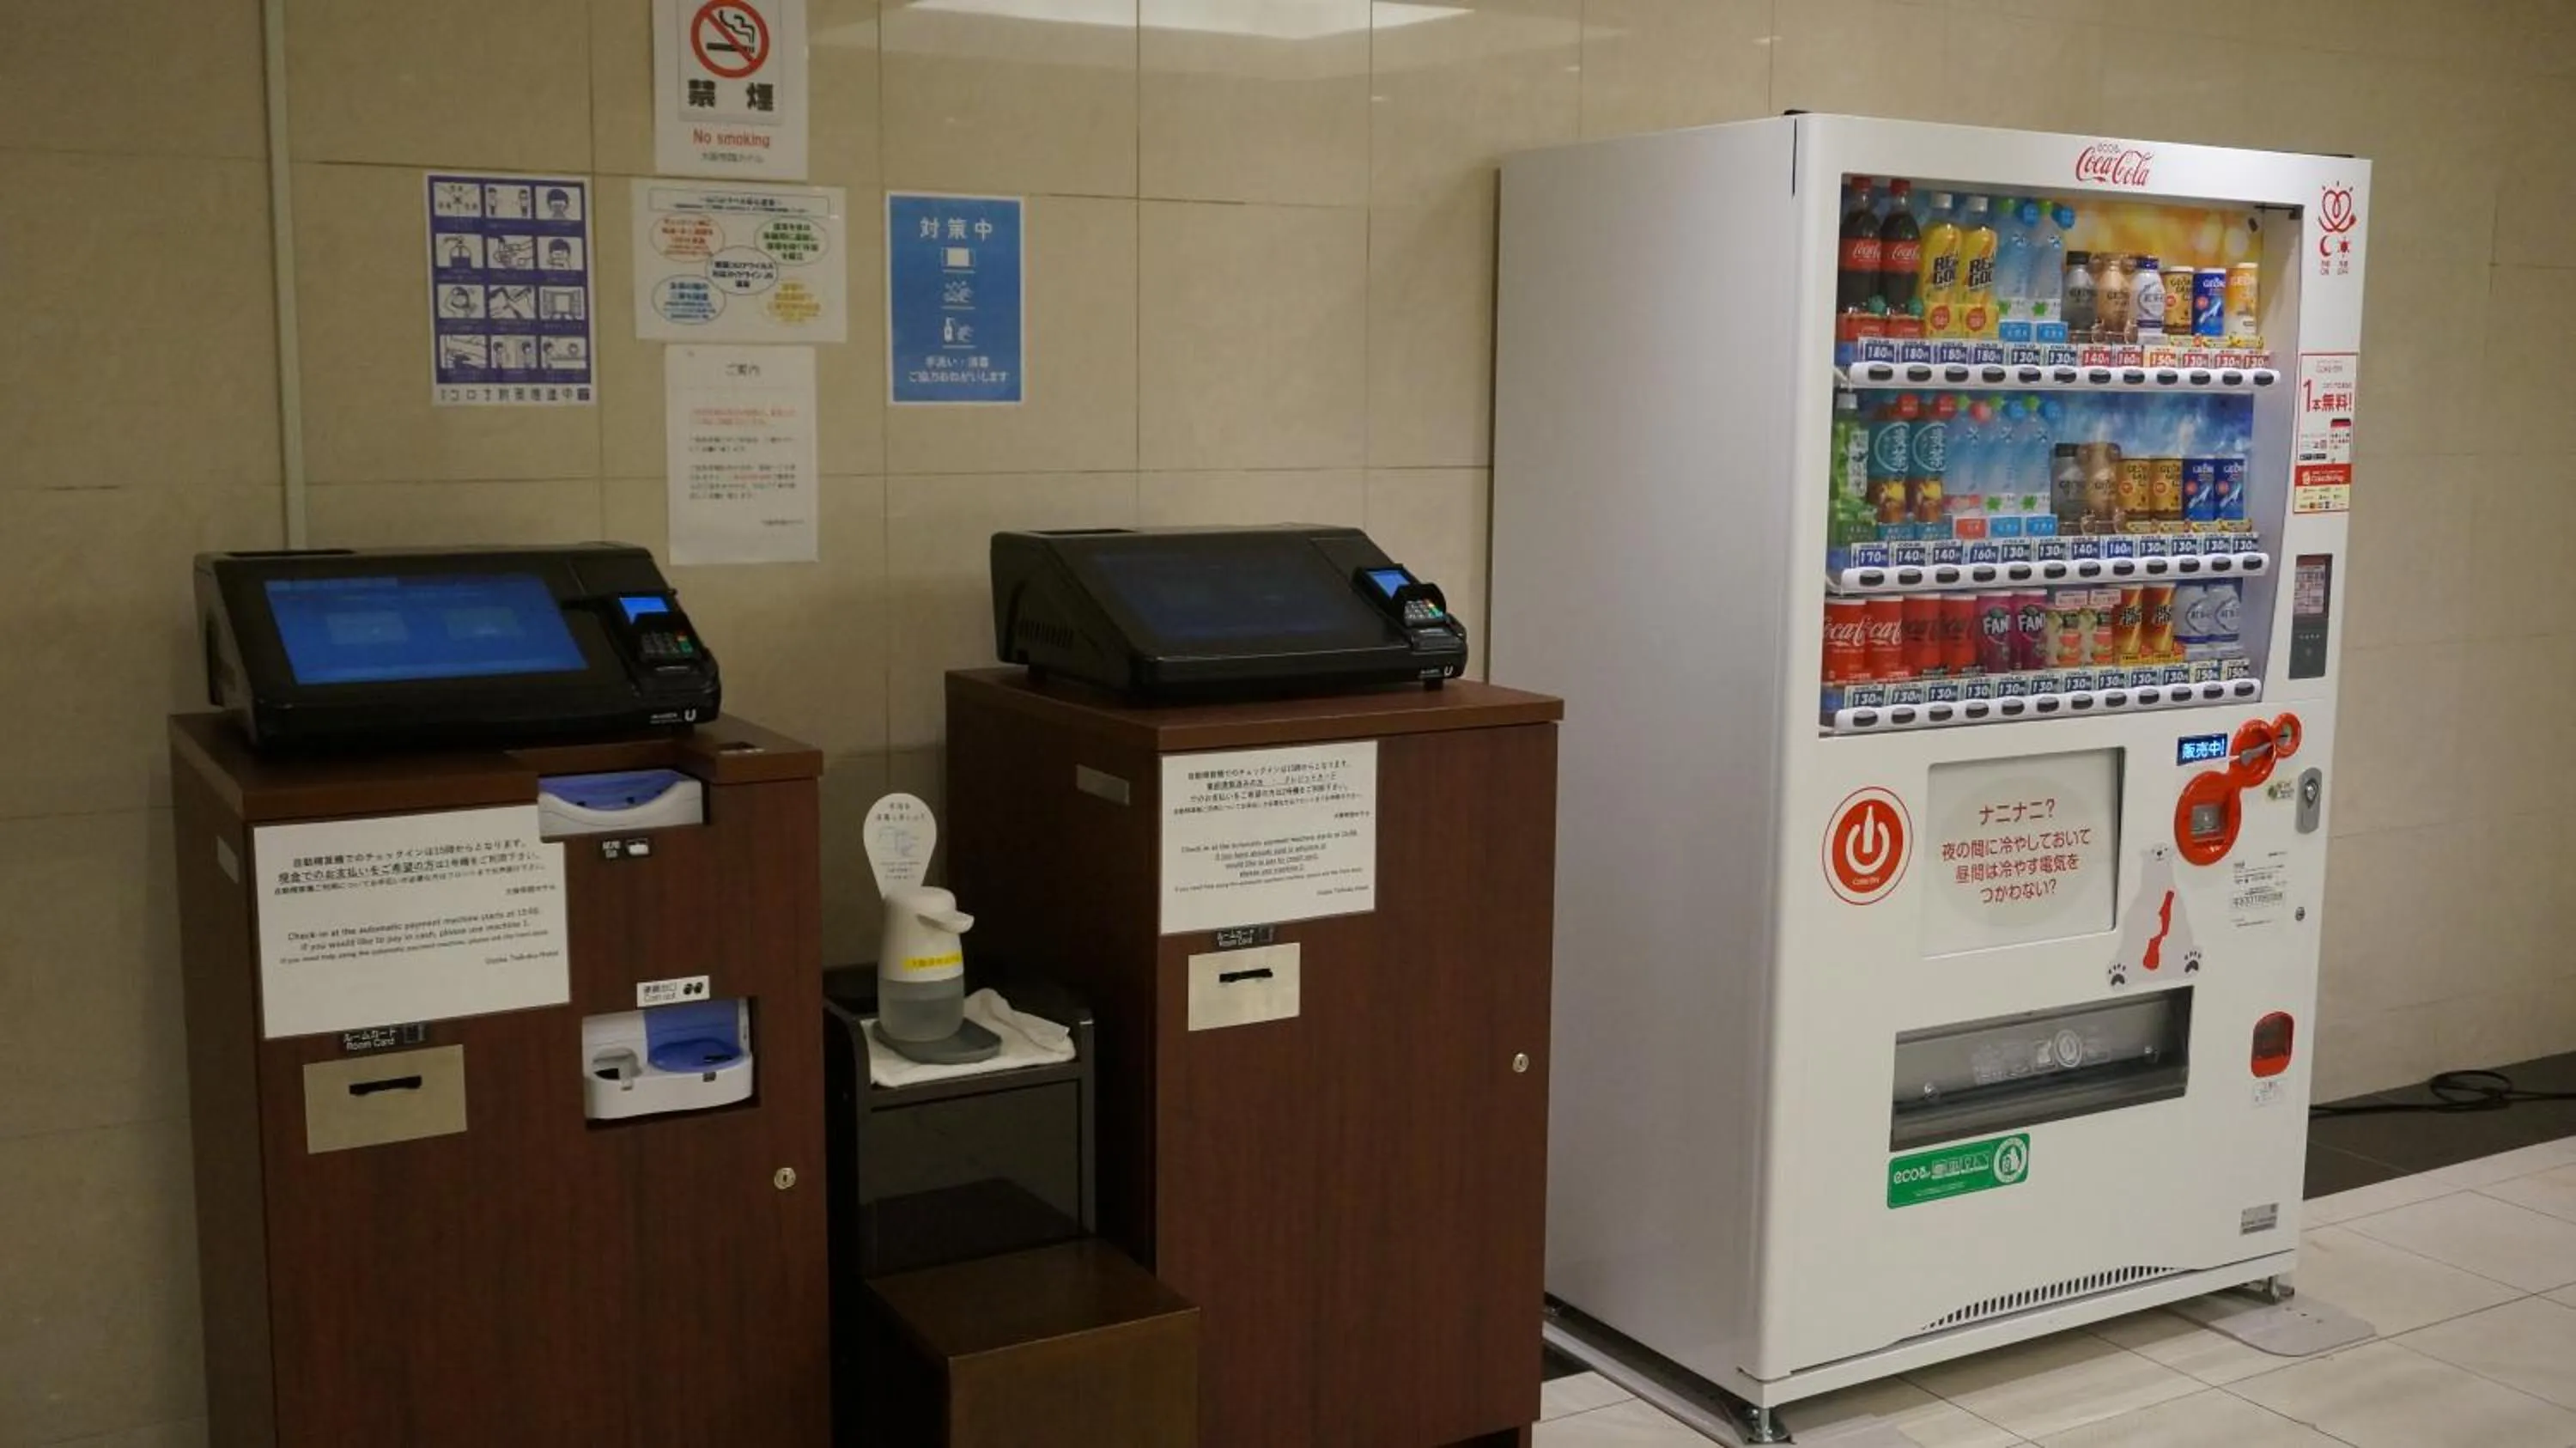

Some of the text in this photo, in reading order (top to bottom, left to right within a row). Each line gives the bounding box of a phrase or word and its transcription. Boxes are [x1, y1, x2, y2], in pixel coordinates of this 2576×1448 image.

[688, 79, 774, 112] 禁煙
[693, 130, 770, 148] No smoking
[2075, 146, 2154, 186] Coca-Cola
[920, 216, 992, 241] 対策中
[726, 364, 760, 376] ご案内
[2181, 740, 2226, 758] 販売中!
[1979, 799, 2056, 825] ナニナニ?
[1941, 828, 2092, 861] 夜の間に冷やしておいて
[1955, 854, 2080, 884] 昼間は冷やす電気を
[1980, 879, 2057, 903] つかわない?
[374, 1037, 395, 1047] Card
